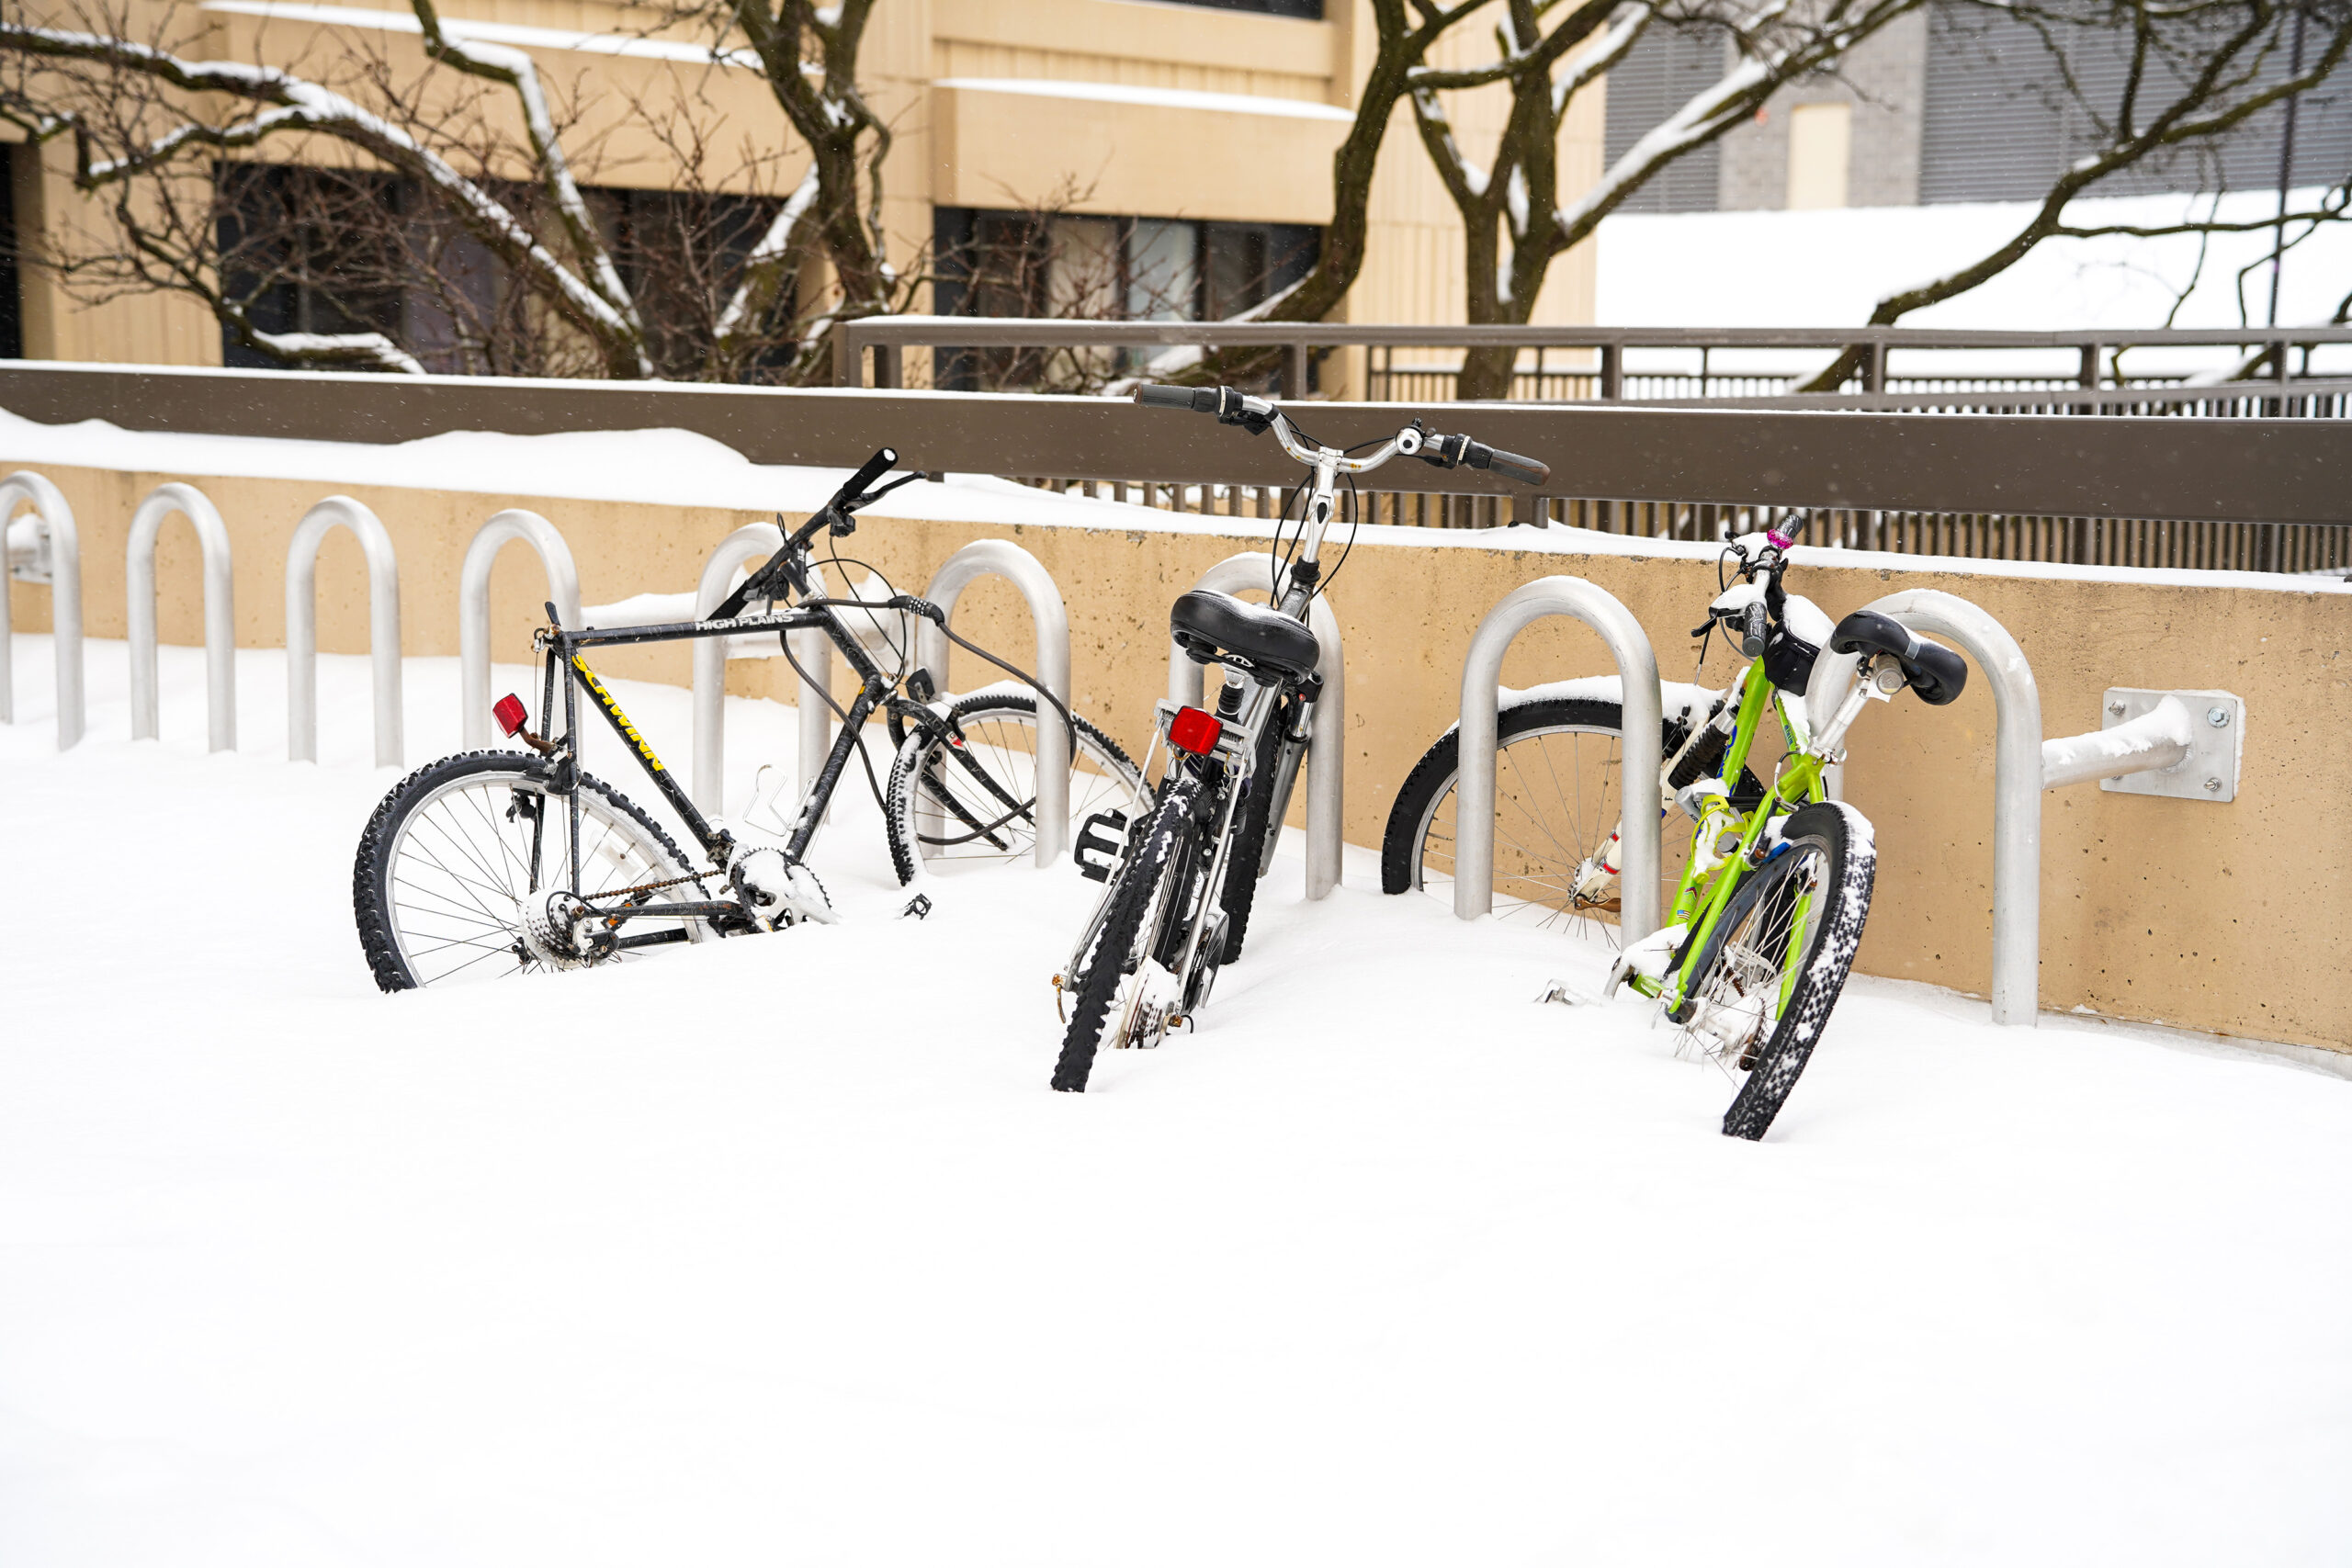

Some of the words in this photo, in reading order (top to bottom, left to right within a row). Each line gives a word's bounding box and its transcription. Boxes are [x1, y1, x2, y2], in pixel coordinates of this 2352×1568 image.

[695, 617, 736, 631] HIGH
[738, 614, 795, 627] PLAINS
[571, 654, 664, 772] SCHWINN
